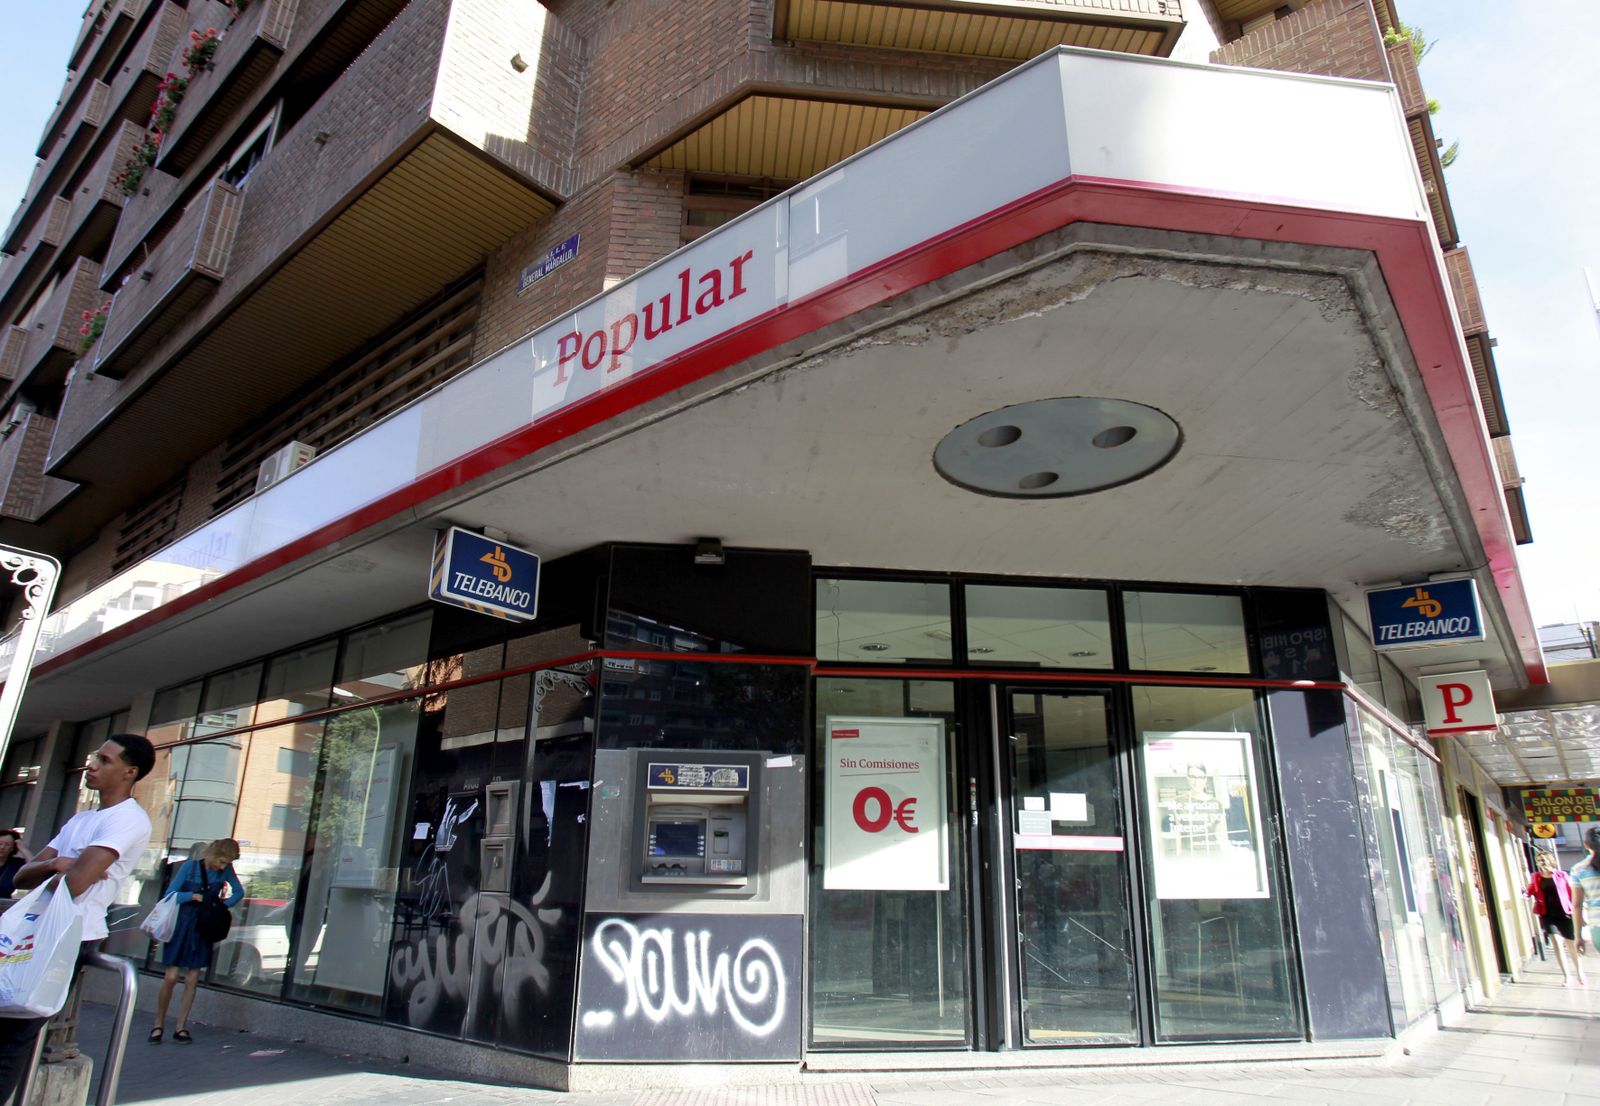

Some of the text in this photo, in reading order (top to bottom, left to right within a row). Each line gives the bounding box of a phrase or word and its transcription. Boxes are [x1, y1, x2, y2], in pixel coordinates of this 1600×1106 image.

[545, 249, 573, 273] MARGALLO
[553, 250, 753, 388] Popular
[453, 571, 530, 609] TELEBANCO
[1379, 616, 1470, 641] TELEBANCO
[1436, 683, 1474, 724] P
[840, 758, 920, 769] Sin Comisiones
[1532, 796, 1593, 806] SALON DE
[1535, 805, 1594, 815] JUEGOS
